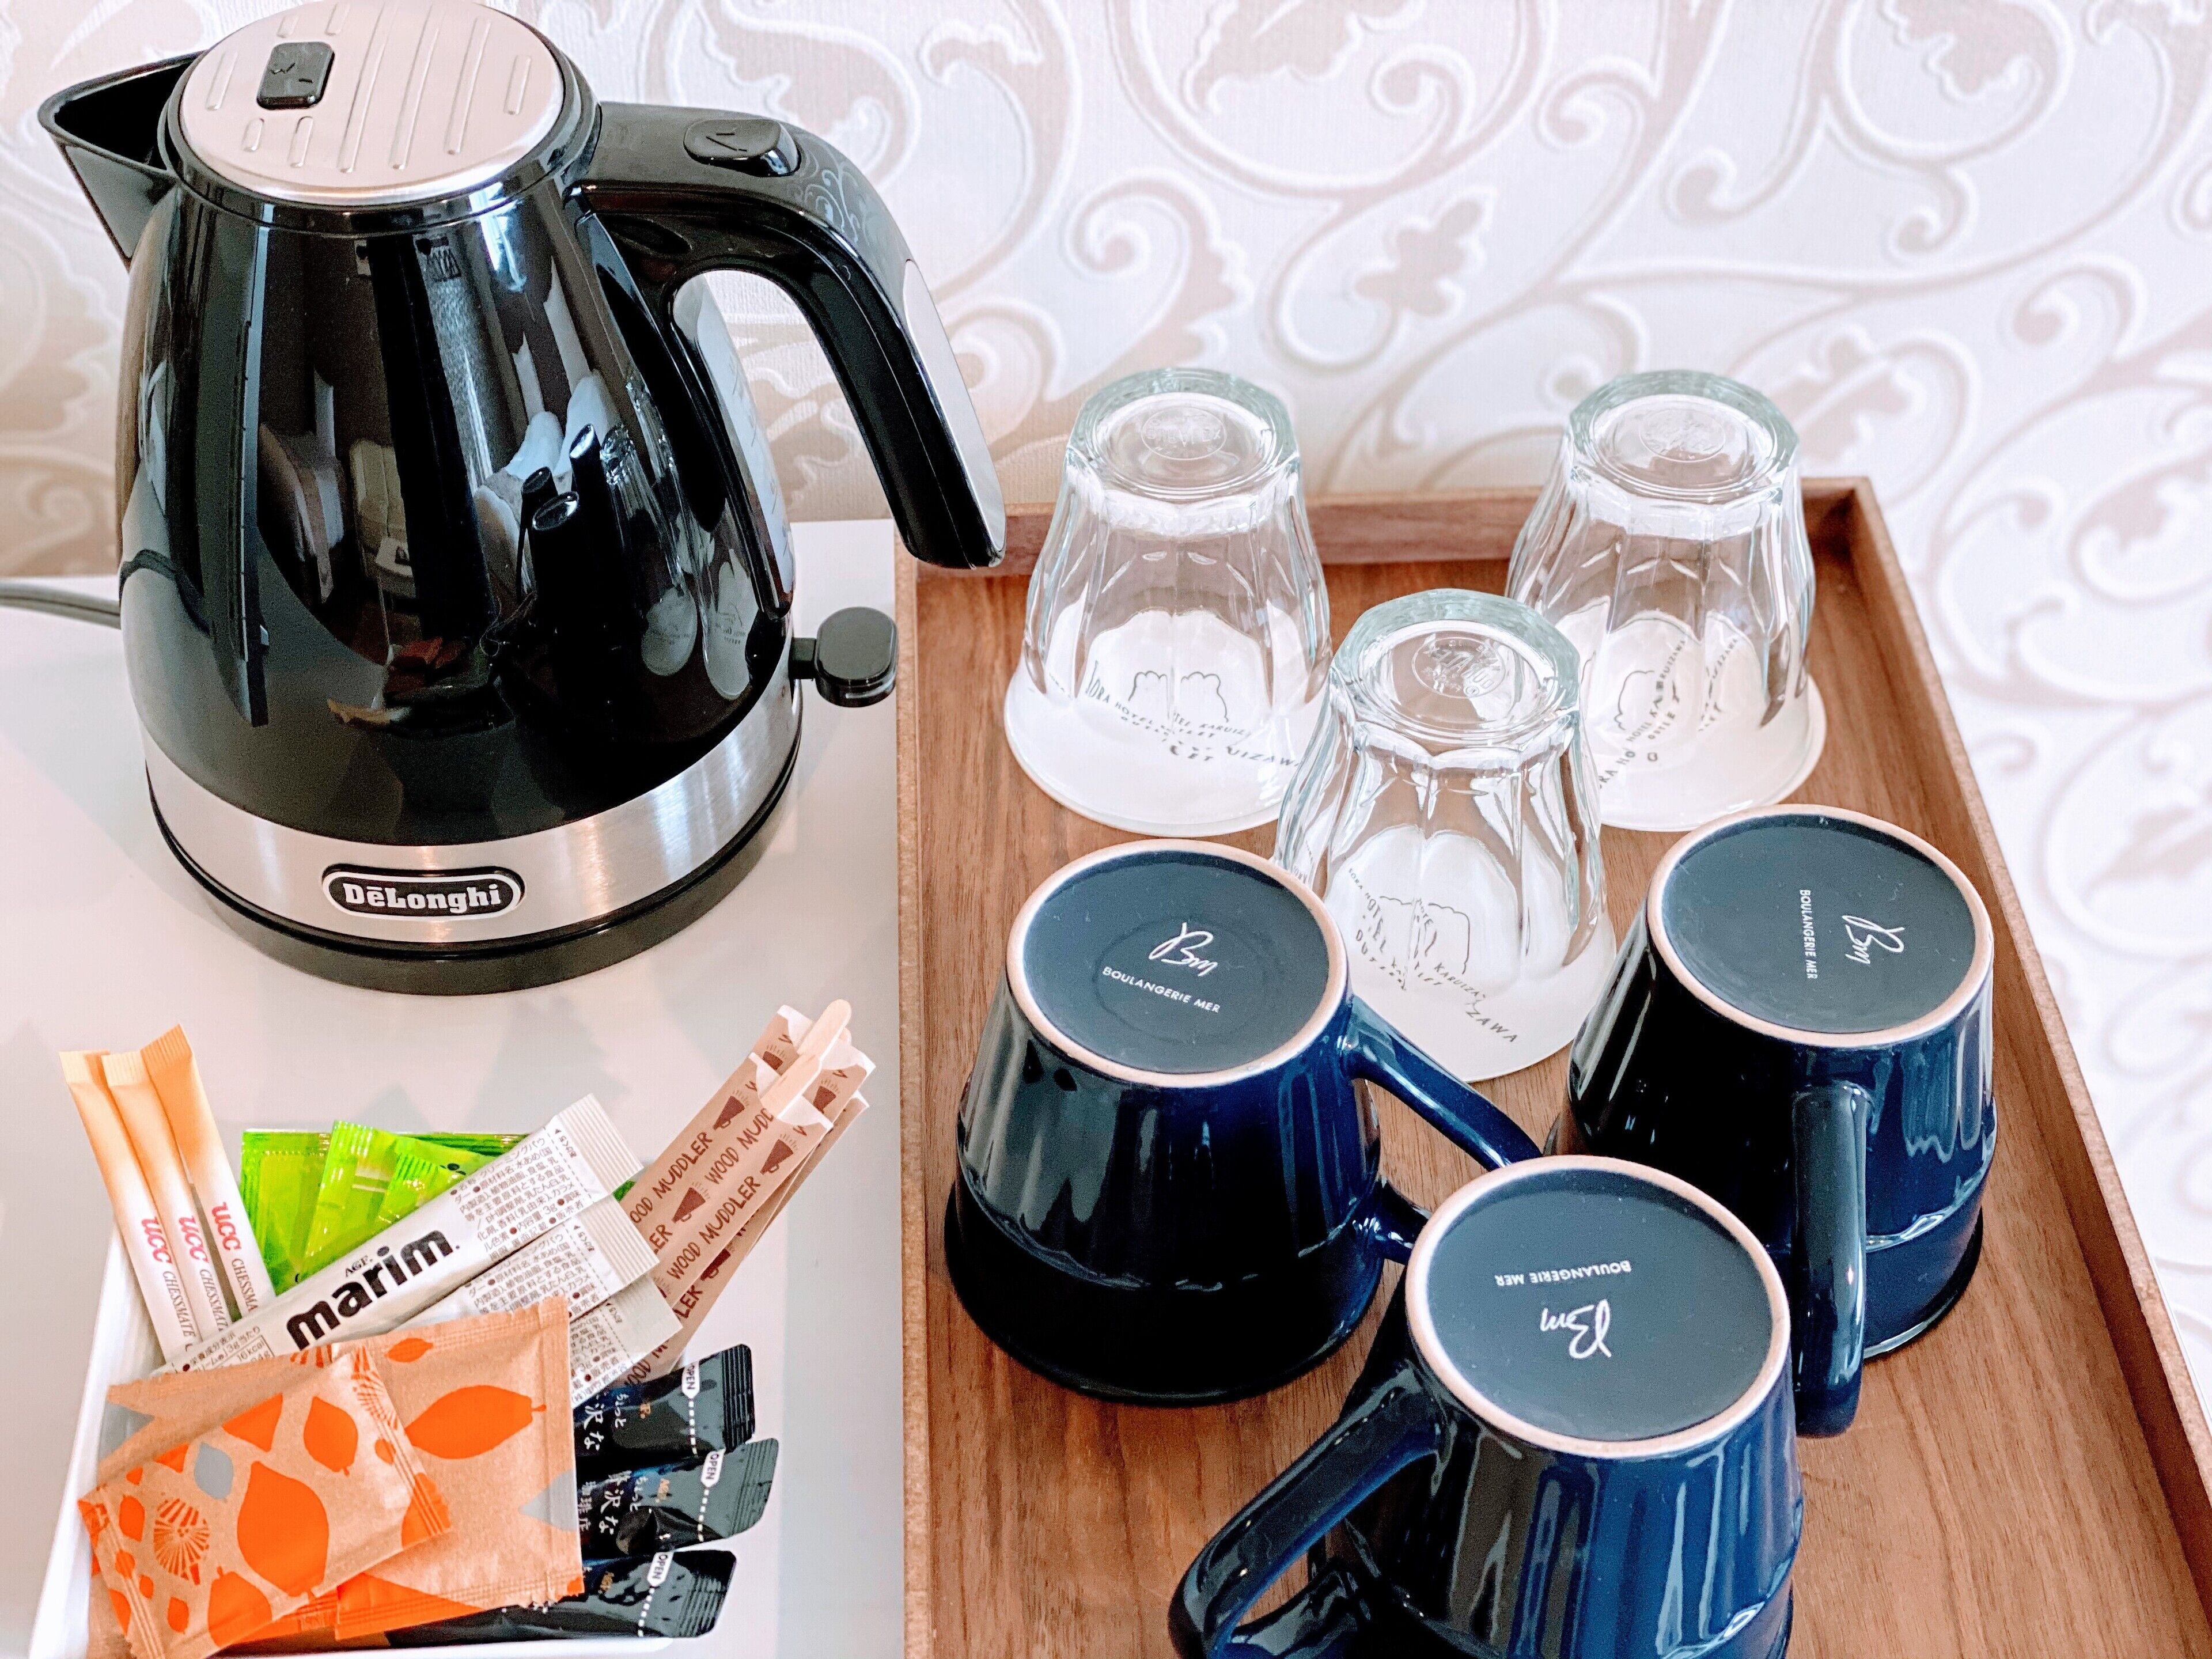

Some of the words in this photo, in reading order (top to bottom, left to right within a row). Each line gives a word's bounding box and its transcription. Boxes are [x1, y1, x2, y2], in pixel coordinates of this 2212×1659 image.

[1800, 889, 1816, 957] BOULANGERIE
[1102, 966, 1192, 1004] BOULANGERIE
[1194, 998, 1221, 1014] MER
[1805, 959, 1818, 979] MER
[703, 1145, 742, 1187] WOOD
[734, 1107, 777, 1152] MUDD
[627, 1195, 656, 1225] OOD
[650, 1130, 715, 1200] MUDDLER
[665, 1240, 703, 1282] WOOD
[696, 1173, 762, 1246] MUDDLER
[231, 1257, 258, 1312] CHESSMA
[1495, 1274, 1525, 1287] MER
[1529, 1260, 1632, 1284] BOULANGERIE
[162, 1270, 195, 1338] CHESSMATE
[199, 1269, 229, 1331] CHESSMAT
[705, 1453, 719, 1481] OPEN
[652, 1554, 669, 1580] OPEN
